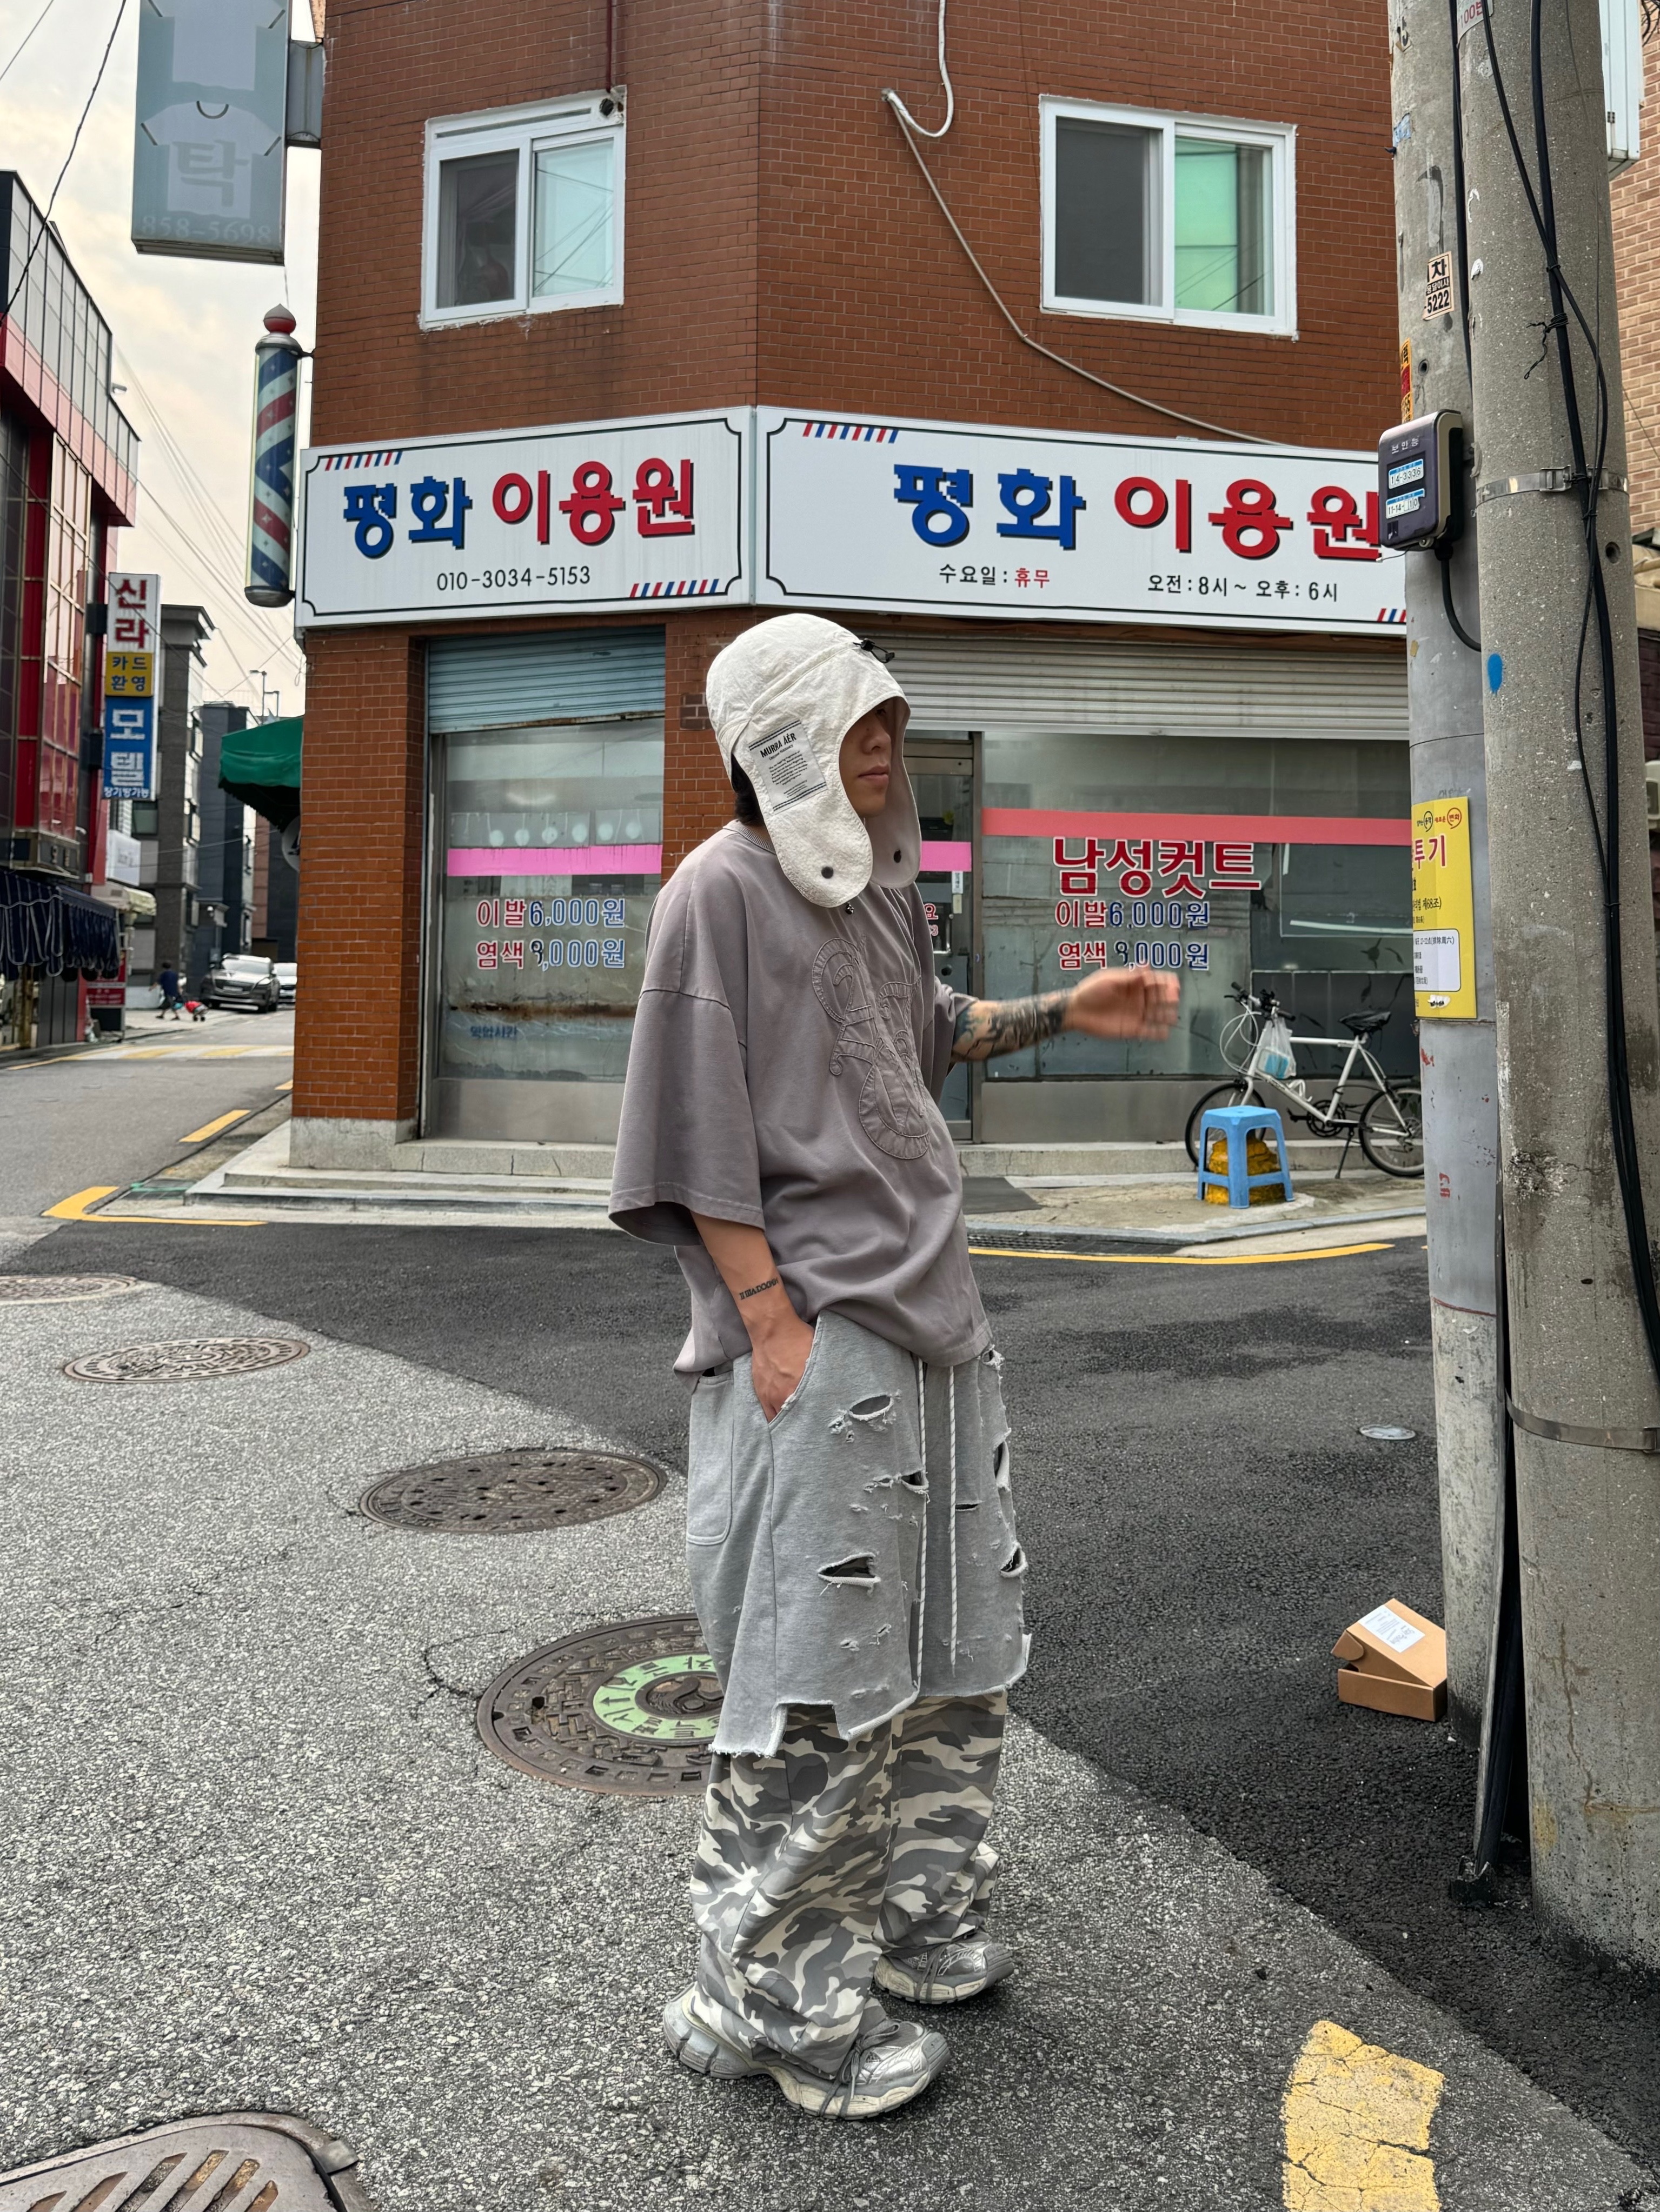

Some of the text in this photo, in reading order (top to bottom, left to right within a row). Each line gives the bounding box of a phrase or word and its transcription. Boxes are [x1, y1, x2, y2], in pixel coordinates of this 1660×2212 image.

[172, 139, 251, 208] 탁
[141, 216, 272, 246] 858-5698
[343, 457, 696, 559] 평화 이용원
[893, 463, 1379, 562] 평화 이용원
[436, 566, 592, 591] 010-3034-5153
[115, 578, 149, 649] 신라
[112, 656, 148, 671] 카드
[111, 675, 146, 692] 환영
[110, 708, 145, 788] 모텔
[760, 740, 783, 758] MURRA
[1053, 837, 1263, 899] 남성컷트
[1412, 835, 1446, 870] 투기
[476, 940, 525, 970] 염색
[1058, 942, 1108, 971] 염색
